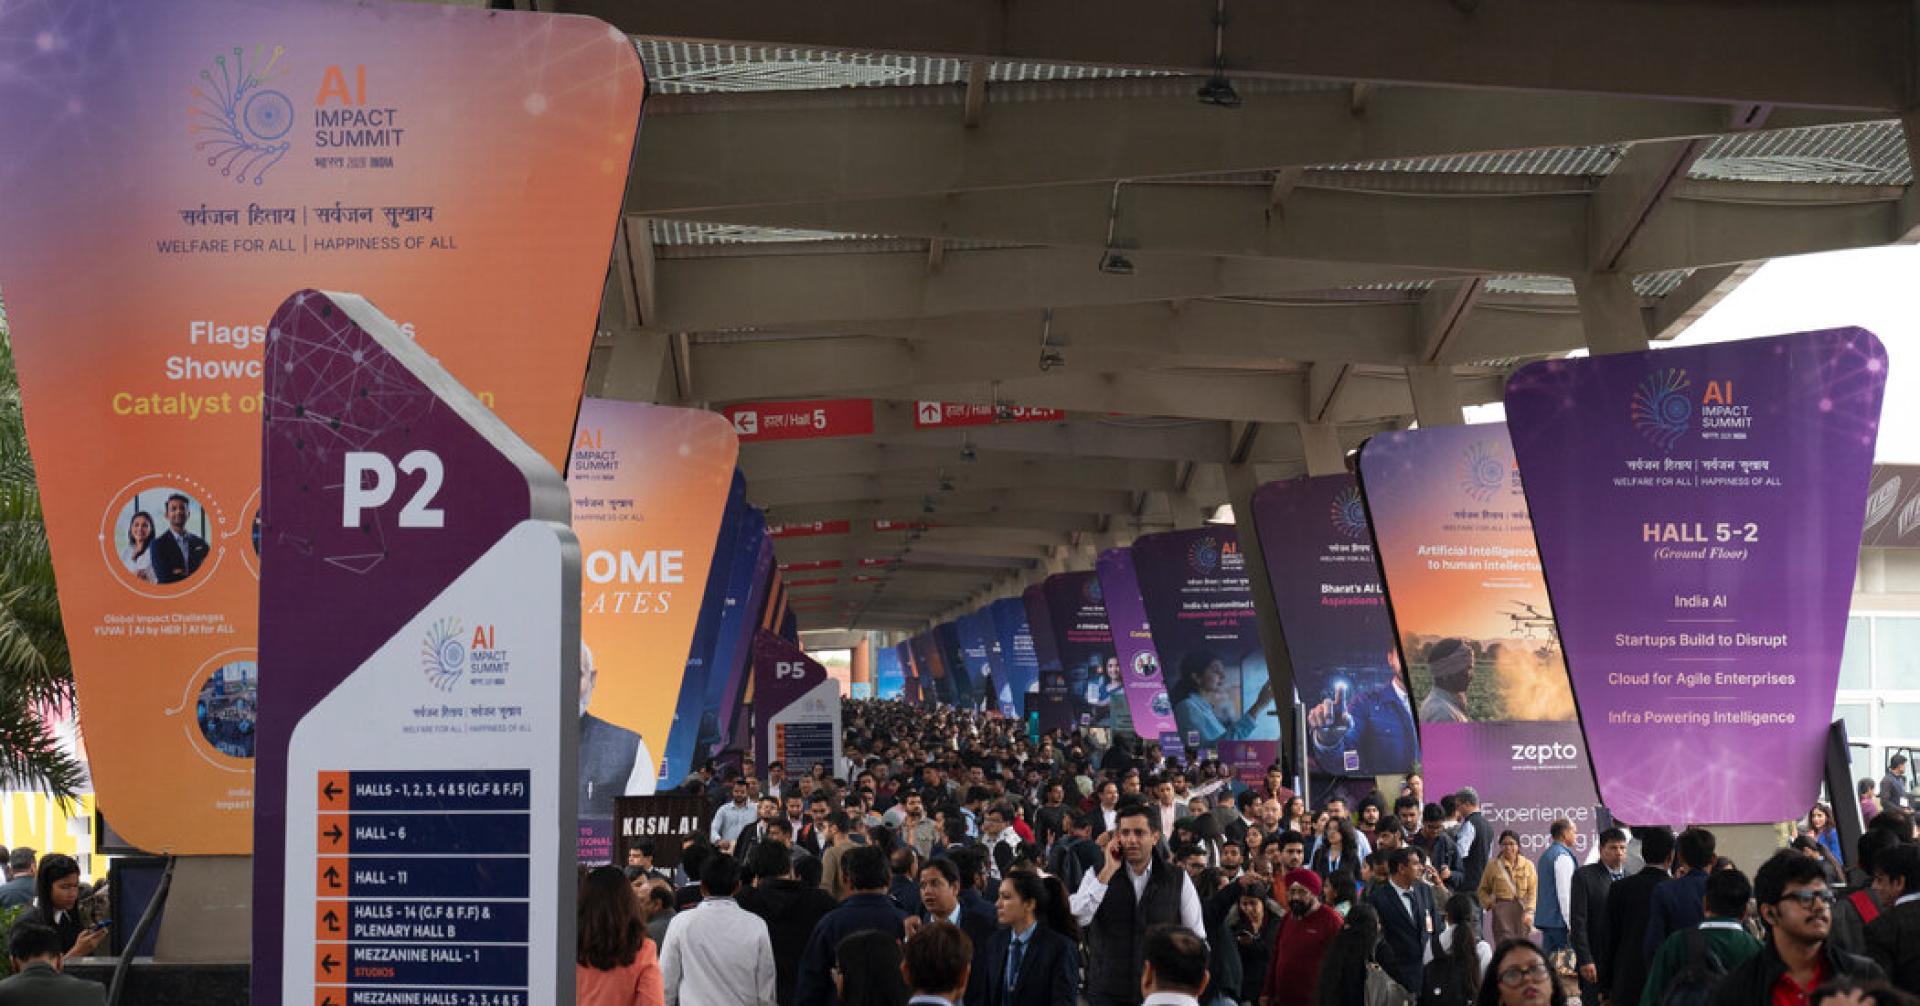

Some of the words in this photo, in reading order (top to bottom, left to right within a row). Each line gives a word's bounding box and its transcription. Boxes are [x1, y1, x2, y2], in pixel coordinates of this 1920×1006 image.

[315, 64, 366, 106] AI
[315, 109, 398, 127] IMPACT
[315, 129, 404, 147] SUMMIT
[157, 239, 229, 253] WELFARE
[233, 239, 264, 252] FOR
[268, 239, 297, 252] ALL
[314, 236, 400, 250] HAPPINESS
[405, 236, 424, 249] OF
[429, 235, 458, 249] ALL
[190, 321, 265, 349] Flags
[166, 355, 263, 381] Showc
[1703, 379, 1734, 405] AI
[112, 391, 230, 420] Catalyst
[1702, 405, 1749, 416] IMPACT
[814, 409, 827, 429] 5
[1702, 417, 1752, 428] SUMMIT
[577, 428, 602, 449] AI
[576, 451, 616, 460] IMPACT
[576, 461, 619, 470] SUMMIT
[341, 449, 445, 528] P2
[1613, 477, 1654, 486] WELFARE
[1657, 477, 1674, 486] FOR
[1675, 477, 1692, 486] ALL
[1701, 477, 1749, 486] HAPPINESS
[1751, 477, 1763, 486] OF
[1765, 477, 1782, 486] ALL
[1643, 523, 1708, 542] HALL
[1716, 523, 1758, 542] 5-2
[1418, 544, 1467, 555] Artificial
[1654, 547, 1707, 560] (Ground
[1709, 547, 1749, 560] Floor)
[586, 550, 684, 584] OME
[1427, 560, 1440, 569] to
[1443, 559, 1482, 570] human
[1484, 560, 1542, 571] intellectu
[1321, 584, 1361, 593] Bharat's
[1364, 584, 1374, 593] AI
[1376, 583, 1383, 593] L
[582, 591, 672, 614] ATES
[1674, 594, 1708, 608] India
[1712, 595, 1727, 608] AI
[104, 614, 133, 623] Global
[137, 614, 168, 625] Impact
[171, 613, 225, 625] Challenges
[135, 625, 145, 634] AI
[160, 625, 182, 634] HER
[216, 624, 236, 634] ALL
[471, 624, 495, 650] AI
[1615, 634, 1676, 648] Startups
[1679, 634, 1714, 646] Build
[1718, 634, 1733, 646] to
[1736, 634, 1788, 648] Disrupt
[470, 651, 507, 661] IMPACT
[470, 662, 510, 673] SUMMIT
[776, 661, 806, 680] P5
[1608, 672, 1649, 685] Cloud
[1652, 672, 1673, 685] for
[1676, 672, 1711, 688] Agile
[1715, 672, 1796, 687] Enterprises
[1608, 711, 1641, 724] Infra
[1644, 711, 1711, 727] Powering
[1713, 711, 1796, 727] Intelligence
[1512, 742, 1577, 763] zepto
[356, 784, 392, 796] HALLS
[402, 784, 410, 797] 1,
[413, 784, 423, 797] 2,
[425, 784, 436, 797] 3,
[438, 784, 445, 795] 4
[447, 783, 455, 795] &
[458, 783, 465, 795] 5
[467, 782, 490, 797] (G.F
[492, 782, 500, 795] &
[502, 782, 524, 797] F.F)
[1480, 802, 1588, 826] Experience
[356, 826, 387, 840] HALL
[398, 826, 407, 840] 6
[355, 871, 387, 884] HALL
[397, 871, 408, 884] 11
[354, 905, 393, 918] HALLS
[404, 905, 416, 918] 14
[419, 904, 444, 920] (G.F
[446, 905, 454, 918] &
[456, 904, 480, 920] F.F)
[481, 905, 490, 918] &
[354, 924, 411, 937] PLENARY
[412, 924, 444, 938] HALL
[447, 924, 456, 938] B
[354, 948, 428, 962] MEZZANINE
[431, 949, 463, 963] HALL
[473, 949, 480, 963] 1
[355, 967, 395, 977] STUDIOS
[353, 992, 422, 1005] MEZZANINE
[423, 993, 458, 1005] HALLS
[468, 994, 478, 1006] 2,
[481, 994, 491, 1006] 3,
[493, 994, 500, 1005] 4
[502, 994, 510, 1006] &
[511, 994, 519, 1006] 5
